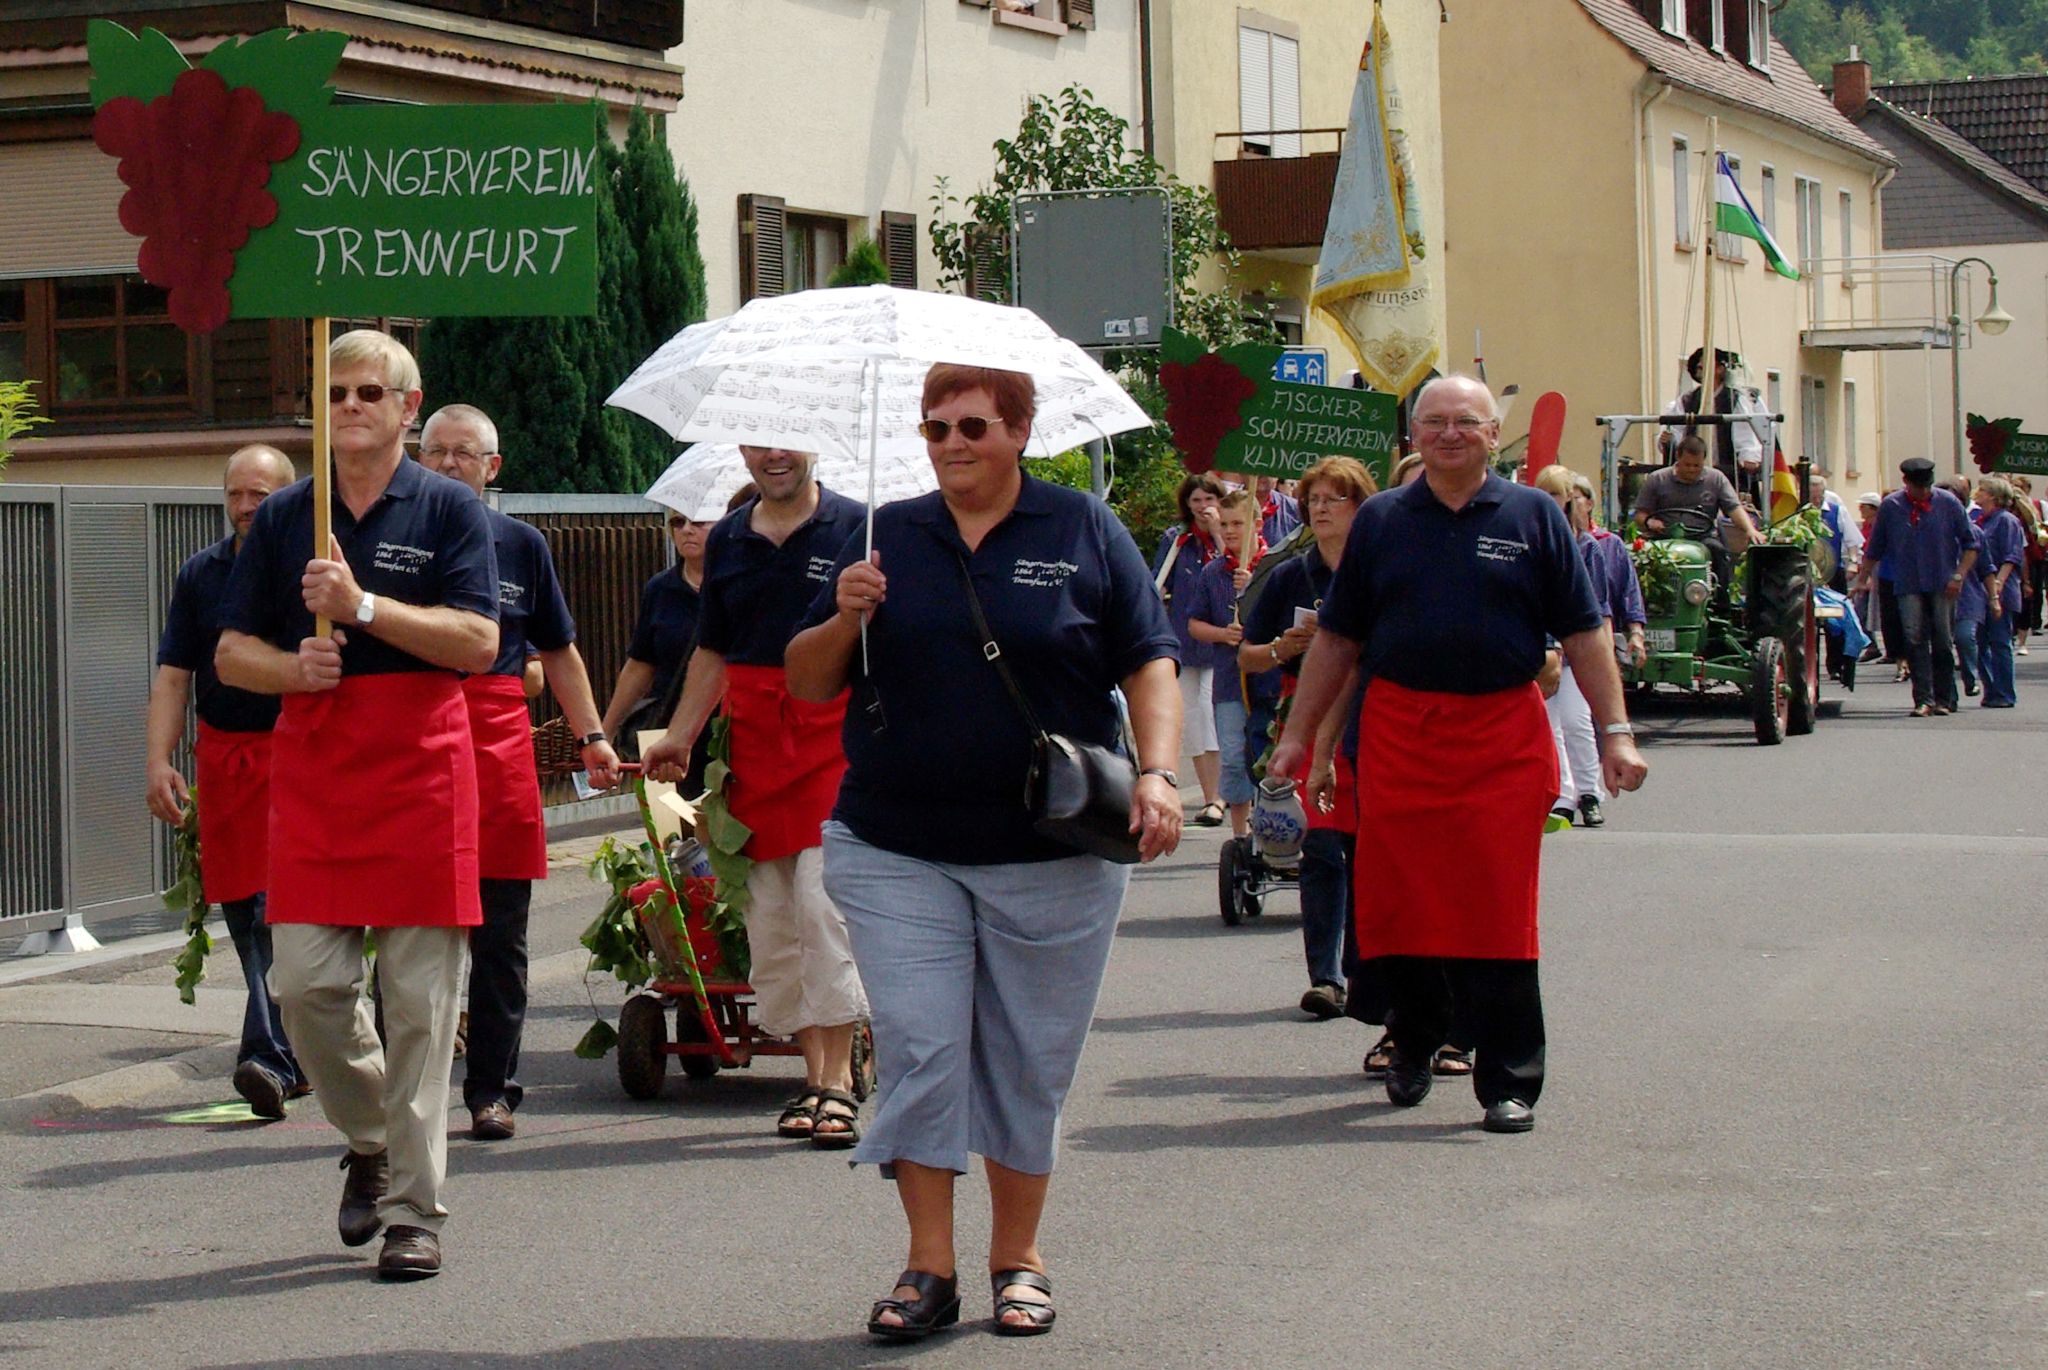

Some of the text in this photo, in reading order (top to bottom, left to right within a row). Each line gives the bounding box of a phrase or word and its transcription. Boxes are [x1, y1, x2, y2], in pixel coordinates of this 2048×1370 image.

[296, 226, 578, 277] TRENNFURT
[1271, 389, 1382, 421] FISCHER &
[1245, 416, 1393, 452] SCHIFFERVEREIN
